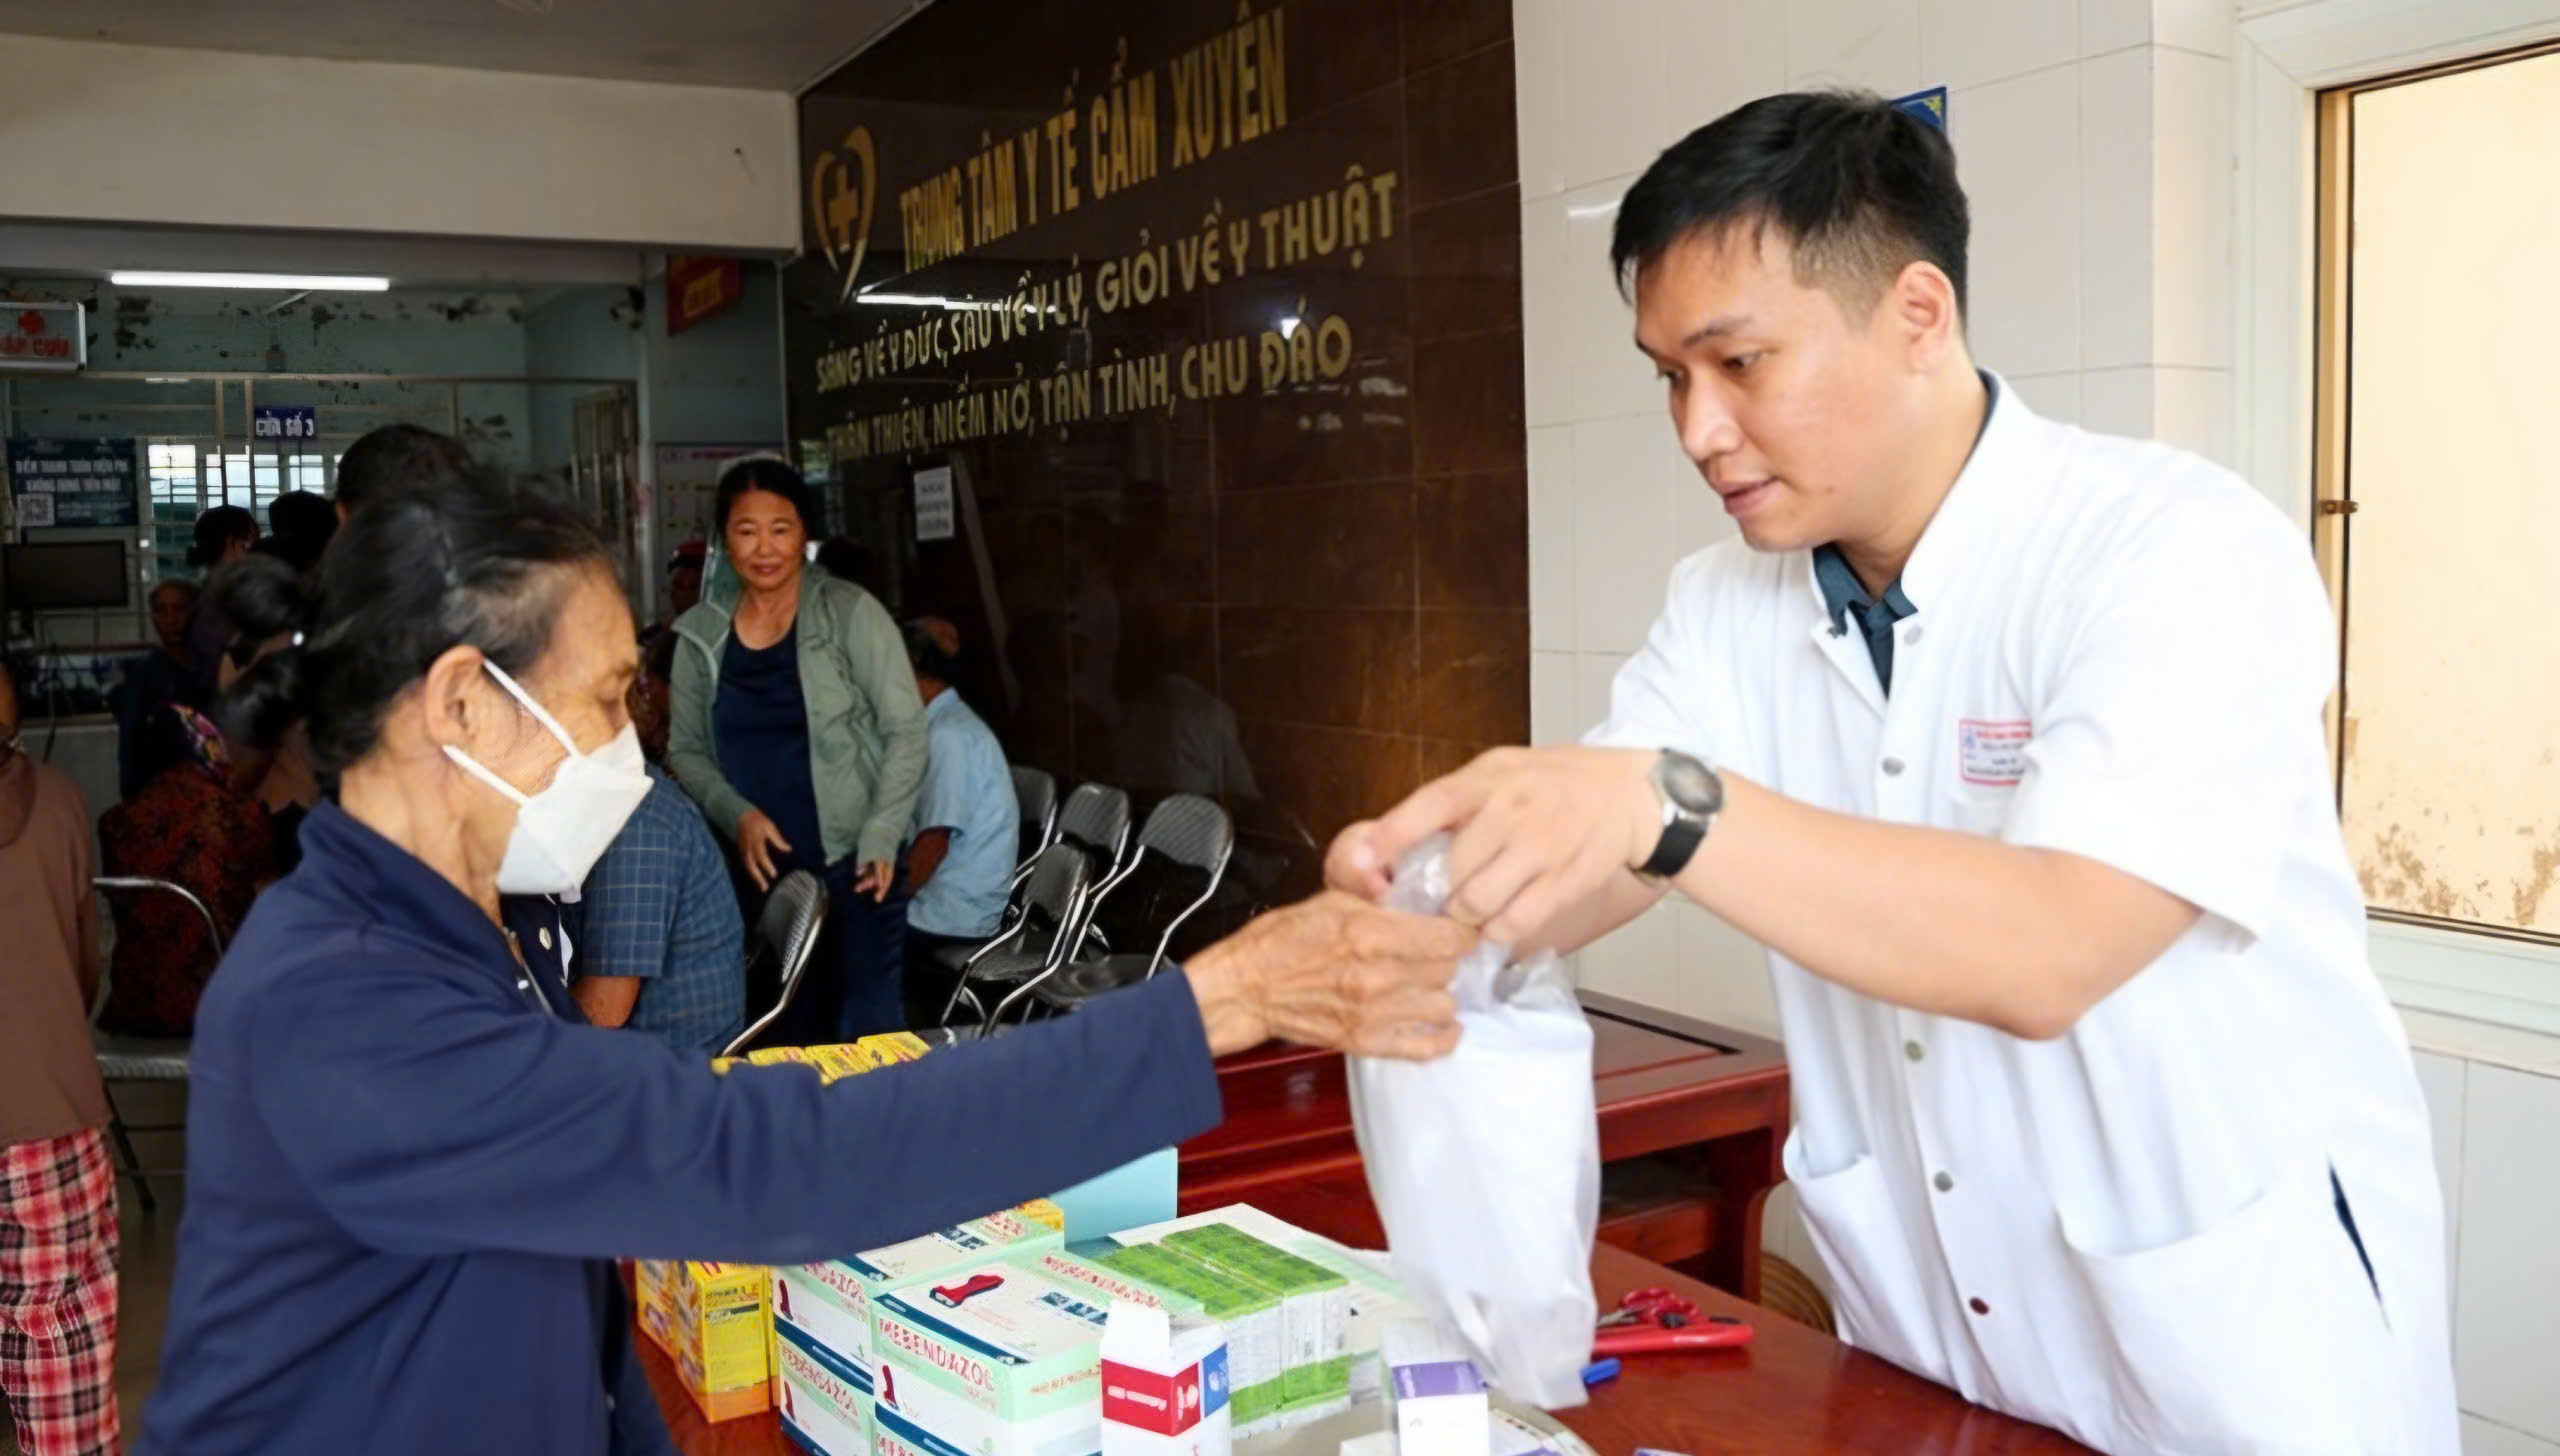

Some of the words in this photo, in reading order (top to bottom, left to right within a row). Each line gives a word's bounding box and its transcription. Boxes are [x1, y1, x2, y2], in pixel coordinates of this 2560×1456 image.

[1022, 127, 1037, 224] Y
[1047, 66, 1080, 215] TẾ
[1090, 36, 1157, 199] CẨM
[1170, 0, 1288, 168] XUYÊN
[888, 331, 899, 373] Y
[1032, 282, 1048, 332] Y
[1096, 226, 1169, 313] GIỎI
[1177, 196, 1225, 293] VỀ
[1227, 217, 1250, 278] Y
[1260, 163, 1398, 270] THUẬT
[1039, 361, 1093, 442] TẬN
[1180, 336, 1249, 399] CHU
[1259, 296, 1353, 392] ĐÁO
